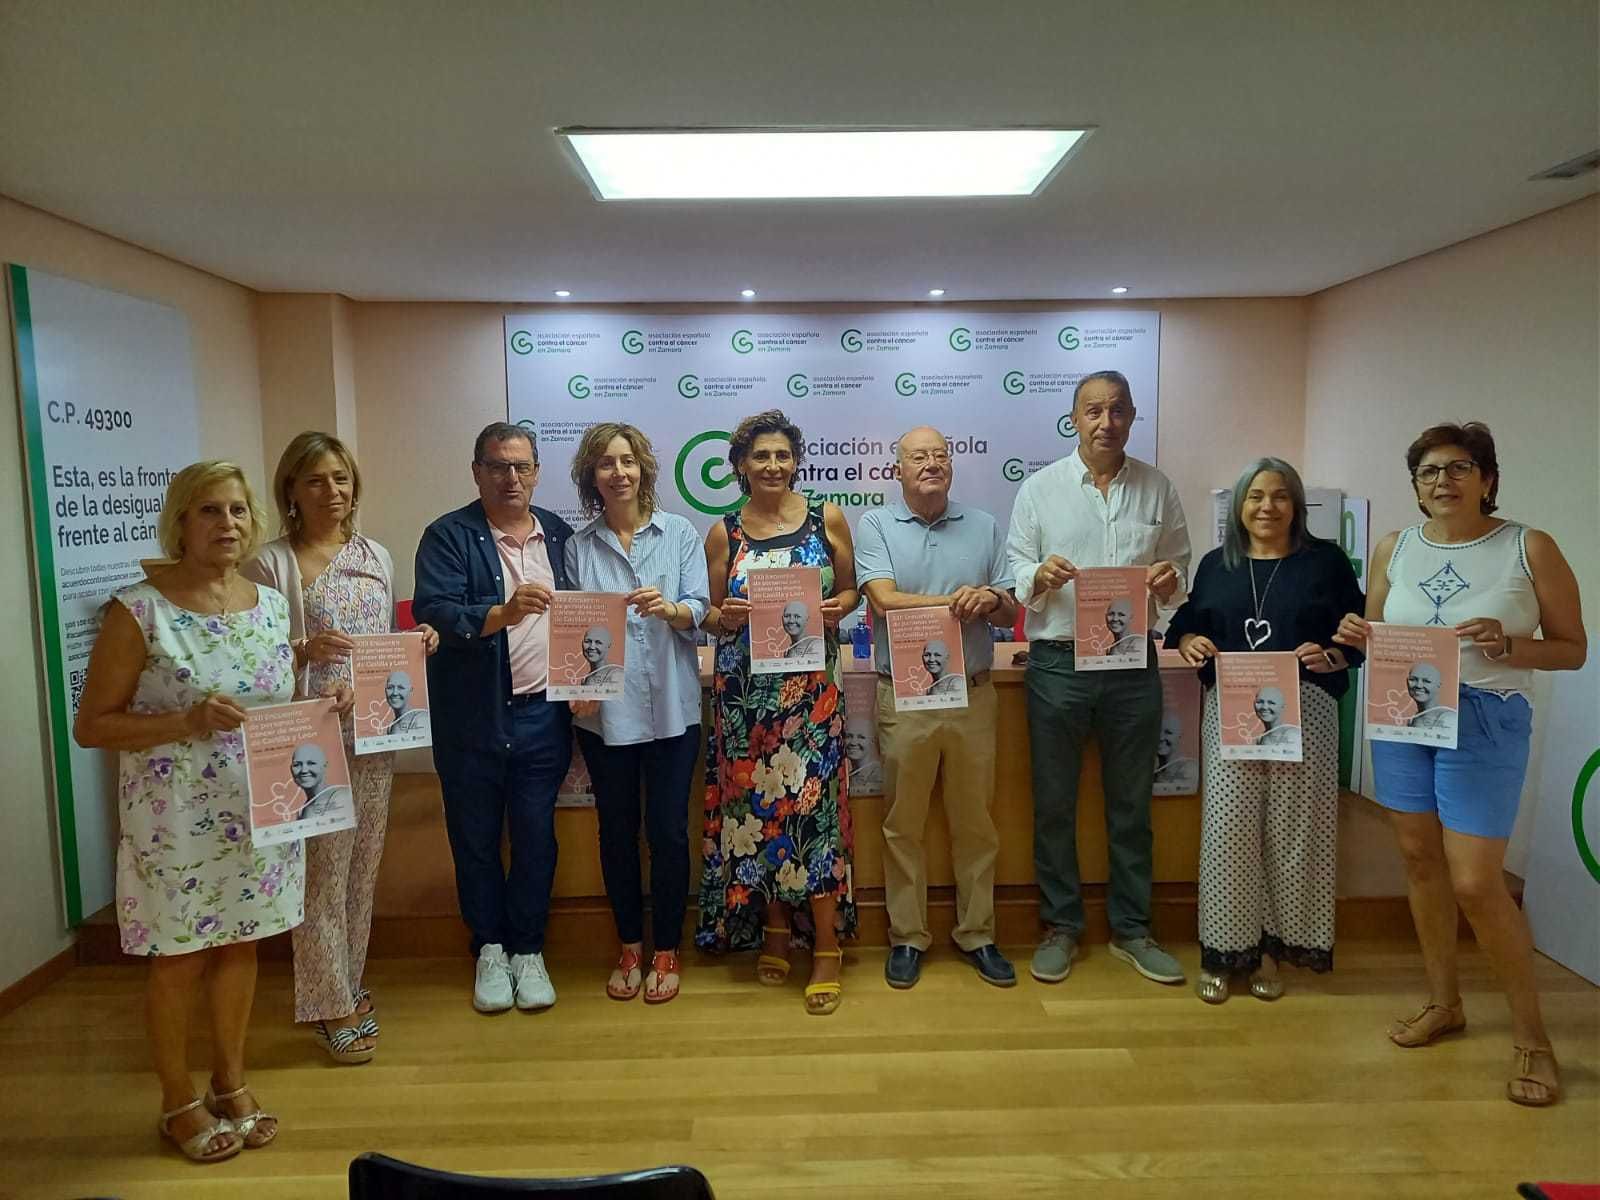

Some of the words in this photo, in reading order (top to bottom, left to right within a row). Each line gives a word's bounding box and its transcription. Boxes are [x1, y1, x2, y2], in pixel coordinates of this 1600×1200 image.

[572, 332, 600, 340] española
[682, 332, 710, 340] española
[792, 331, 820, 339] española
[900, 330, 930, 338] española
[1010, 329, 1038, 337] española
[1118, 328, 1146, 336] española
[566, 338, 587, 346] cáncer
[676, 338, 697, 346] cáncer
[895, 336, 916, 344] cáncer
[628, 376, 656, 384] española
[738, 376, 766, 384] española
[848, 375, 876, 383] española
[954, 374, 984, 382] española
[732, 382, 753, 390] cáncer
[949, 380, 970, 388] cáncer
[48, 400, 80, 424] C.P.
[85, 407, 132, 431] 49300
[796, 463, 838, 481] ntra
[845, 462, 862, 481] el
[52, 465, 94, 490] Esta,
[99, 470, 117, 487] es
[120, 465, 135, 487] la
[55, 495, 78, 518] de
[82, 494, 98, 517] la
[102, 494, 164, 519] desigual
[57, 524, 109, 547] frente
[113, 521, 129, 543] al
[131, 519, 158, 541] cán
